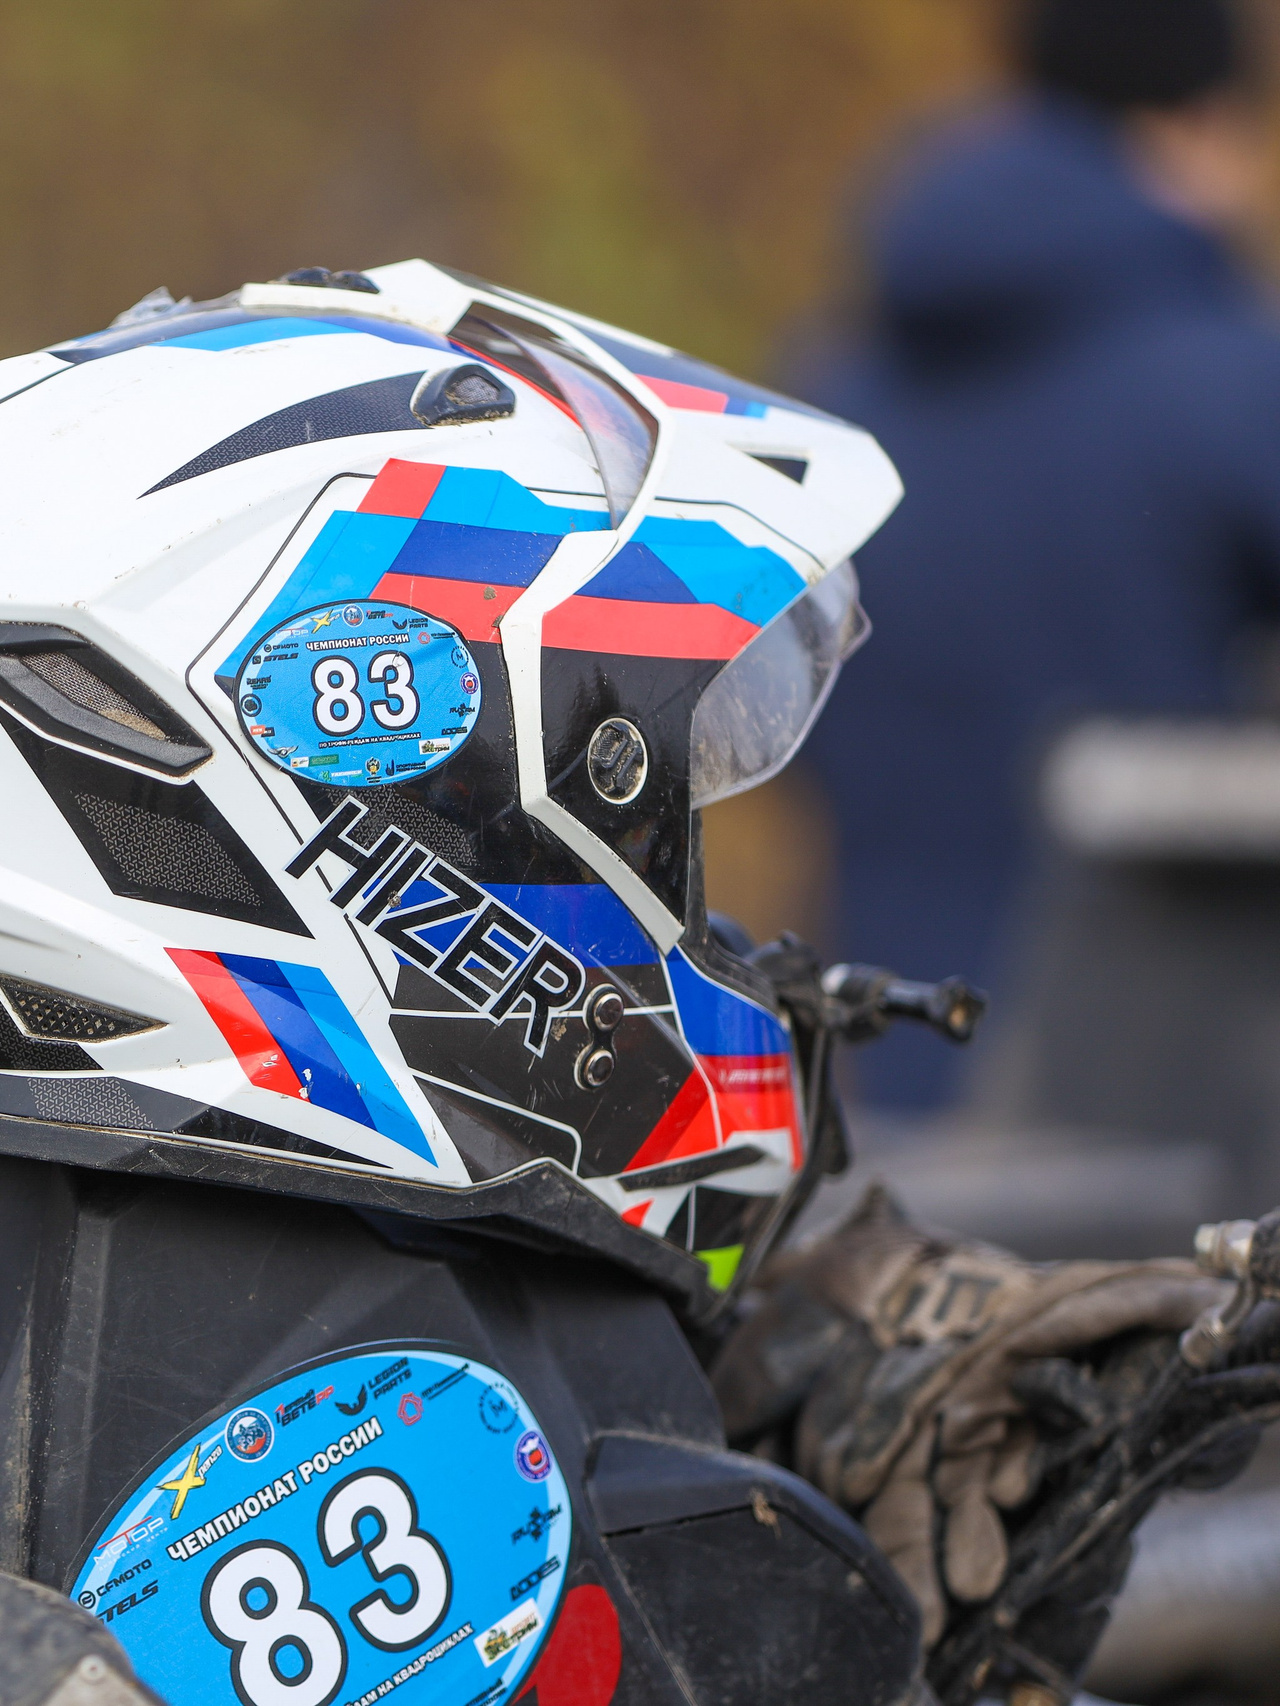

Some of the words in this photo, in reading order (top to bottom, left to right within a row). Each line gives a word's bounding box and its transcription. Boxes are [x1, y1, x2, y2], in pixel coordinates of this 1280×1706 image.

[263, 652, 299, 663] STELS
[306, 637, 367, 651] ЧЕМПИОНАТ
[369, 633, 410, 645] РОССИИ
[311, 650, 420, 737] 83
[283, 795, 587, 1058] HIZER
[368, 1357, 409, 1389] LEGION
[374, 1369, 412, 1400] PARTS
[166, 1471, 299, 1562] ЧЕМПИОНАТ
[297, 1416, 384, 1484] РОССИИ
[96, 1558, 152, 1597] CFMOTO
[200, 1467, 452, 1706] 83
[376, 1679, 395, 1698] НА
[392, 1621, 474, 1686] КВАДРОЦИКЛАХ
